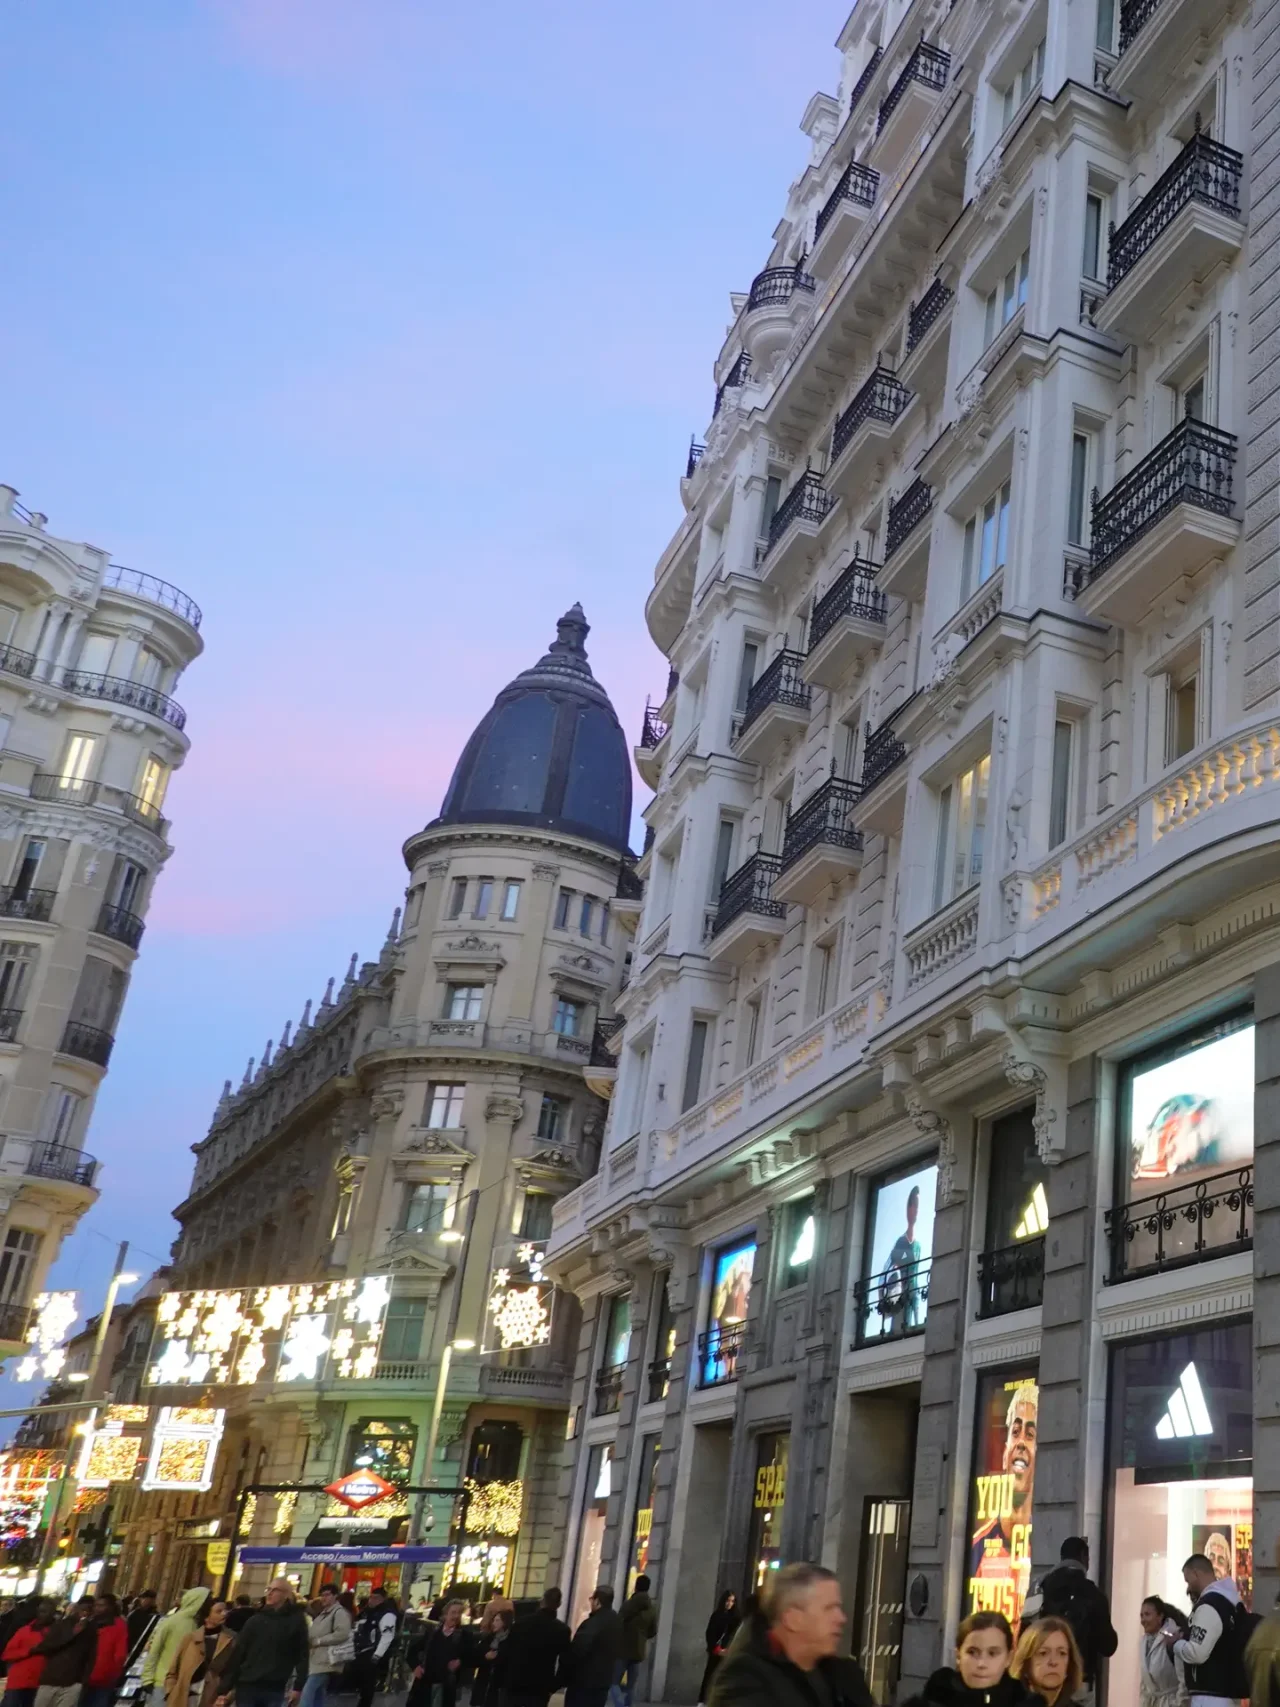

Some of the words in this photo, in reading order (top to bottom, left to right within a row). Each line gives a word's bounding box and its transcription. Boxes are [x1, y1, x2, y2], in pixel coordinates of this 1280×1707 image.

[344, 1484, 377, 1495] Metro
[976, 1473, 1016, 1519] YOU
[362, 1551, 399, 1560] Montera
